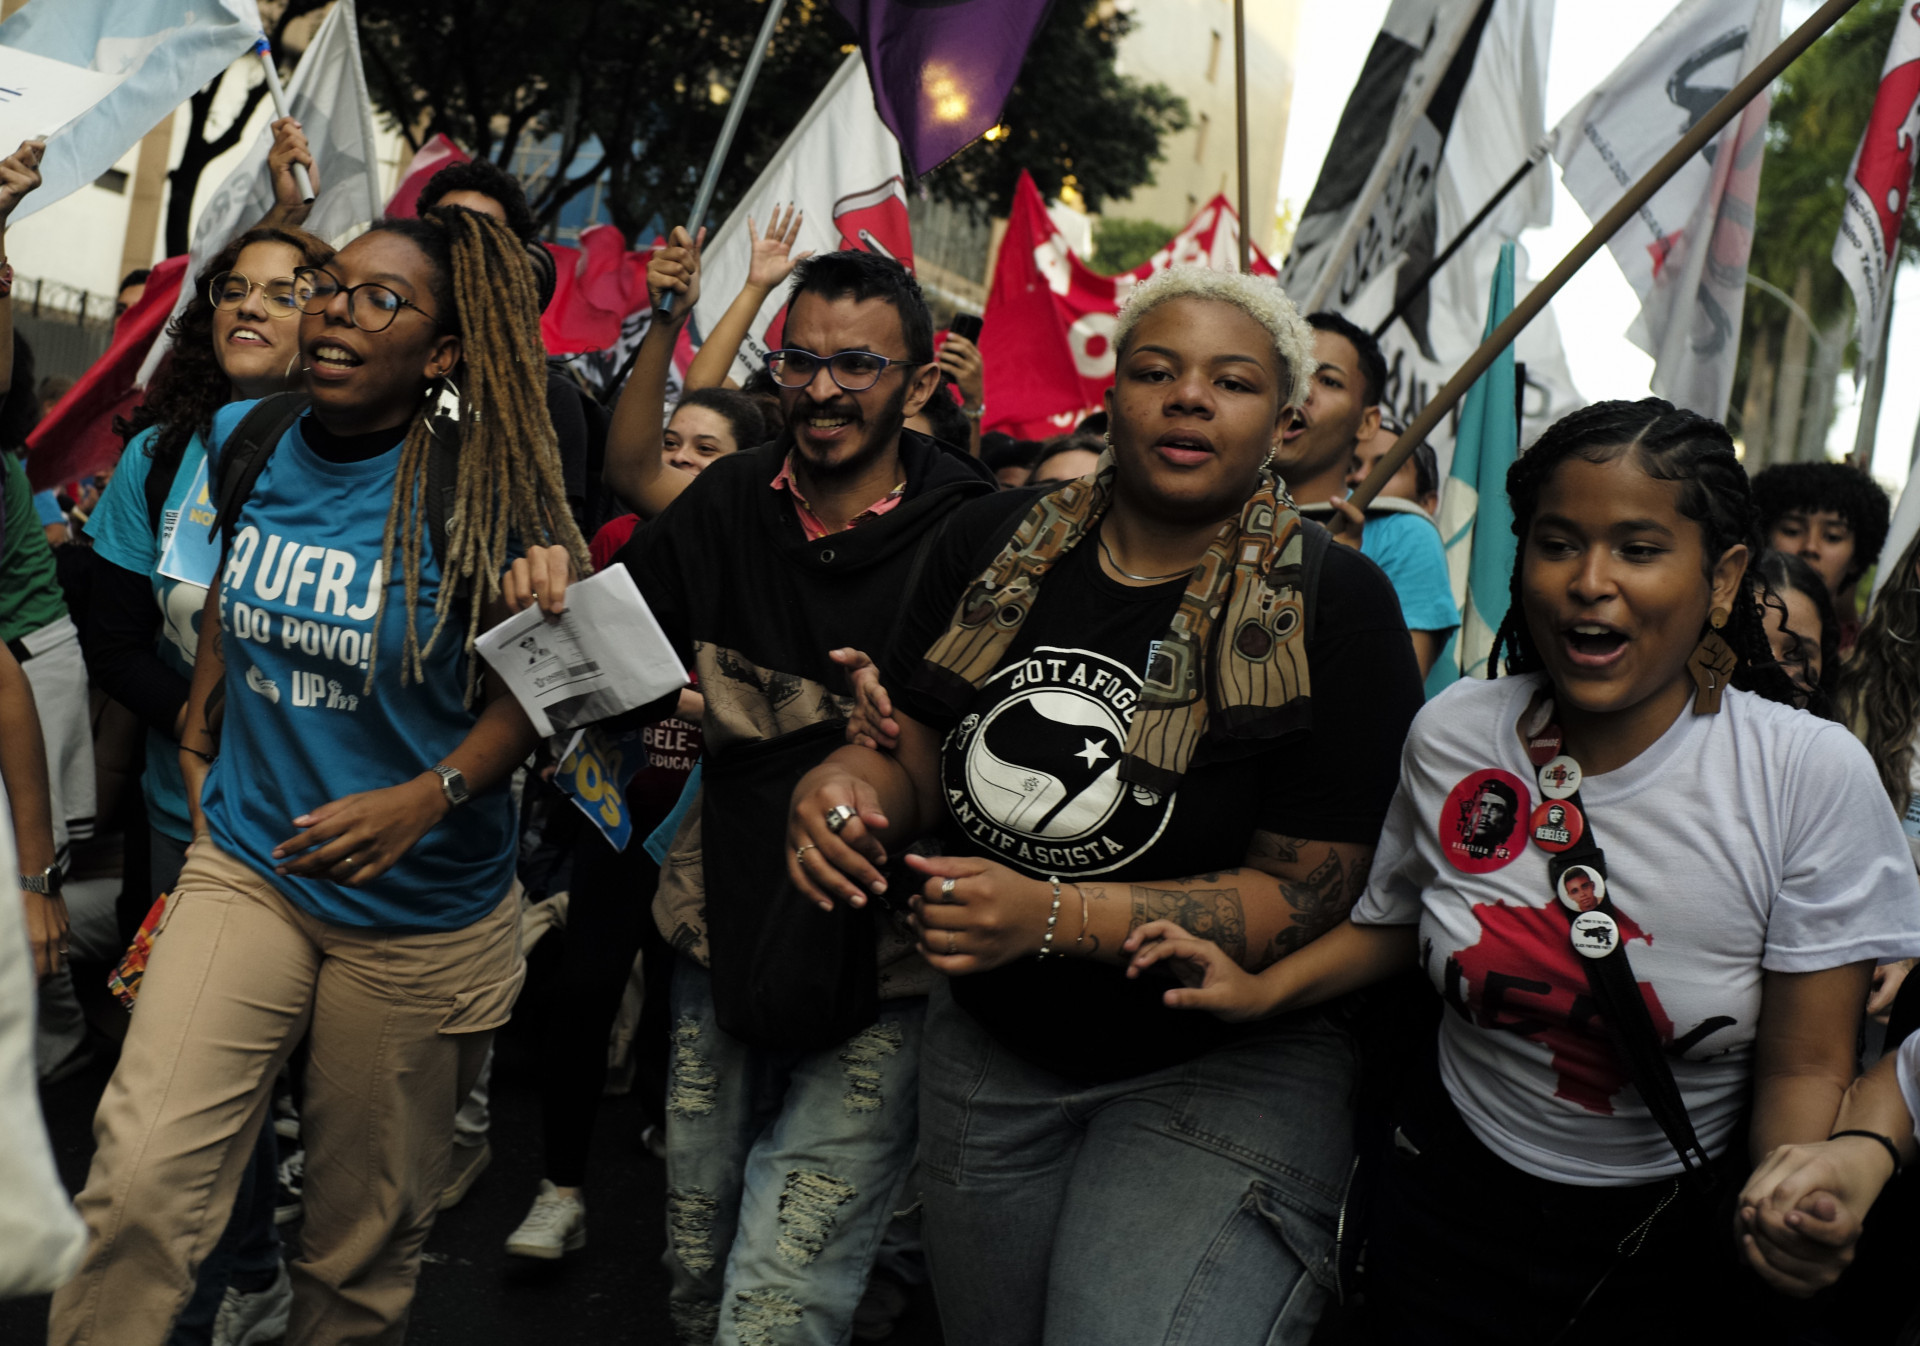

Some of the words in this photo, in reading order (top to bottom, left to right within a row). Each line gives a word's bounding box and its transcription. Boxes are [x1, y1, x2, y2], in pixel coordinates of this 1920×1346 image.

[223, 525, 261, 590] A
[254, 534, 383, 621] UFRJ
[233, 601, 272, 644] DO
[281, 615, 373, 670] POVO!
[291, 670, 327, 707] UP
[948, 788, 1125, 868] ANTIFASCISTA
